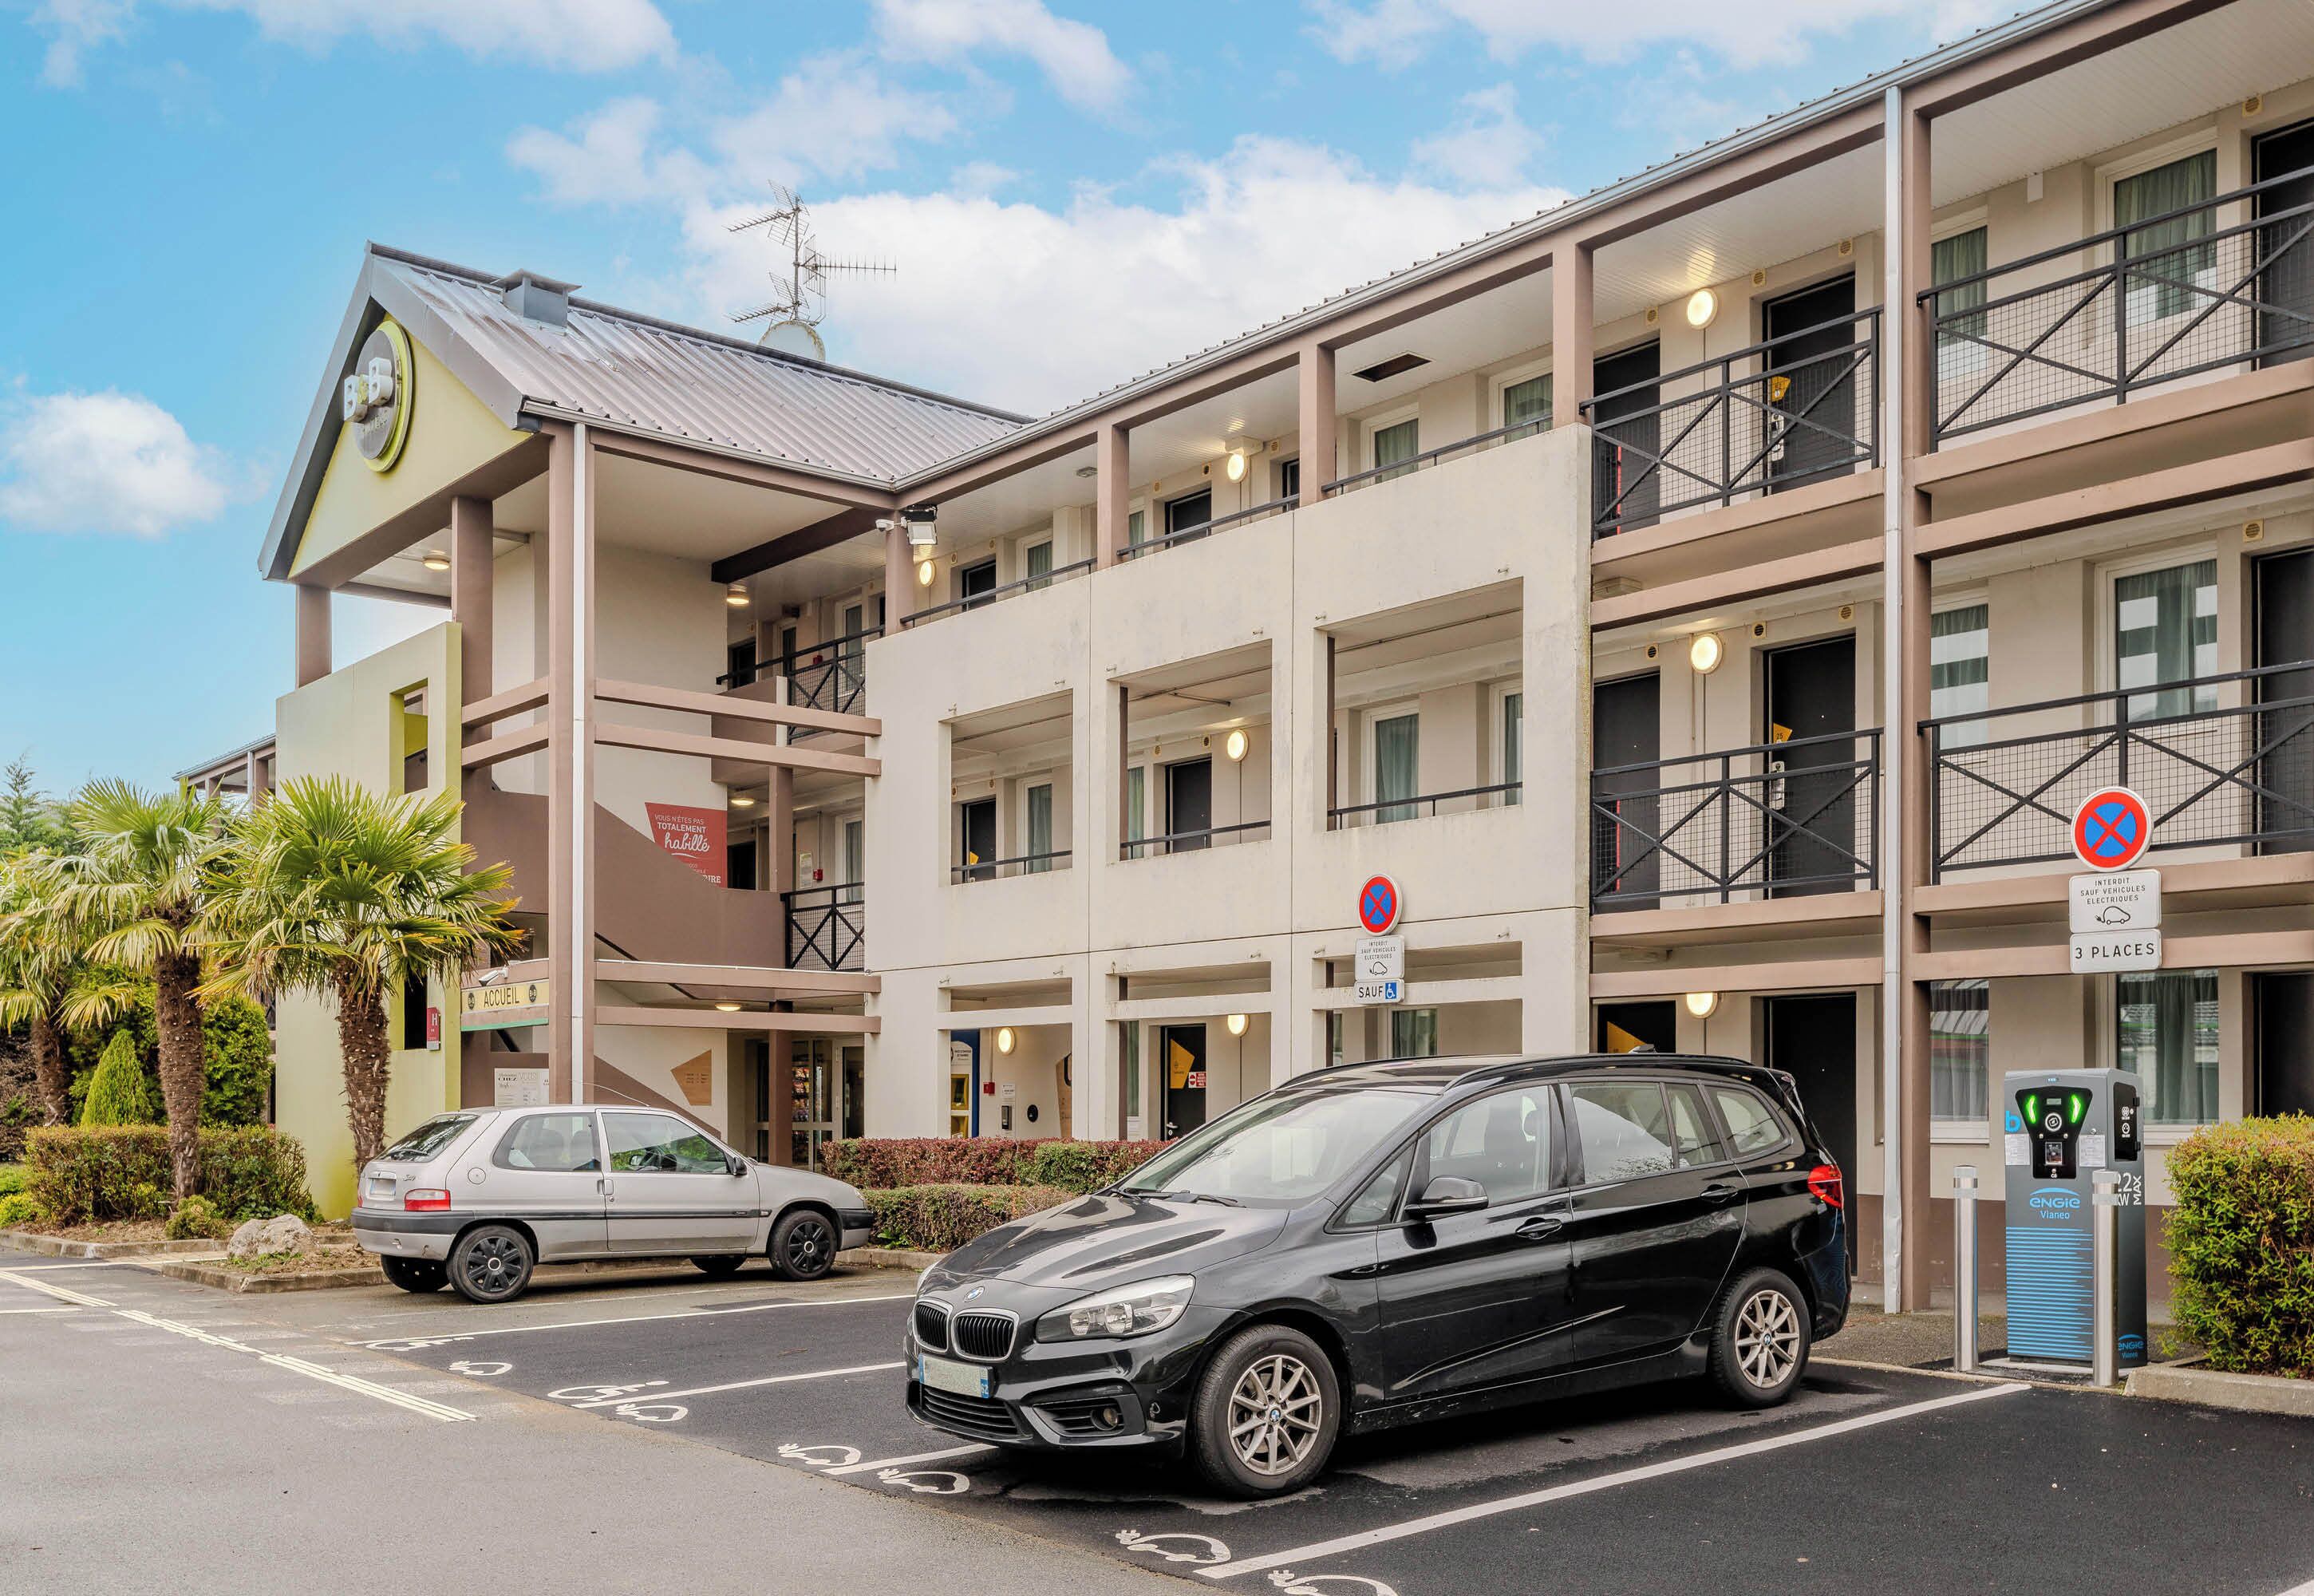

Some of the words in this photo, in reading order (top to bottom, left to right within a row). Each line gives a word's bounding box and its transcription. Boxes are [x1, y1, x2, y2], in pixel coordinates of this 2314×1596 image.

[657, 822, 707, 833] TOTALEMENT
[665, 832, 710, 852] habillé
[2103, 885, 2146, 894] VEHICULES
[2087, 895, 2139, 904] ELECTRIQUES
[2075, 947, 2083, 959] 3
[2091, 942, 2154, 958] PLACES
[484, 986, 519, 1007] ACCUEIL
[1358, 986, 1384, 998] SAUF
[432, 1013, 438, 1026] H
[2133, 1175, 2142, 1206] MAX
[2040, 1211, 2070, 1219] Vianeo
